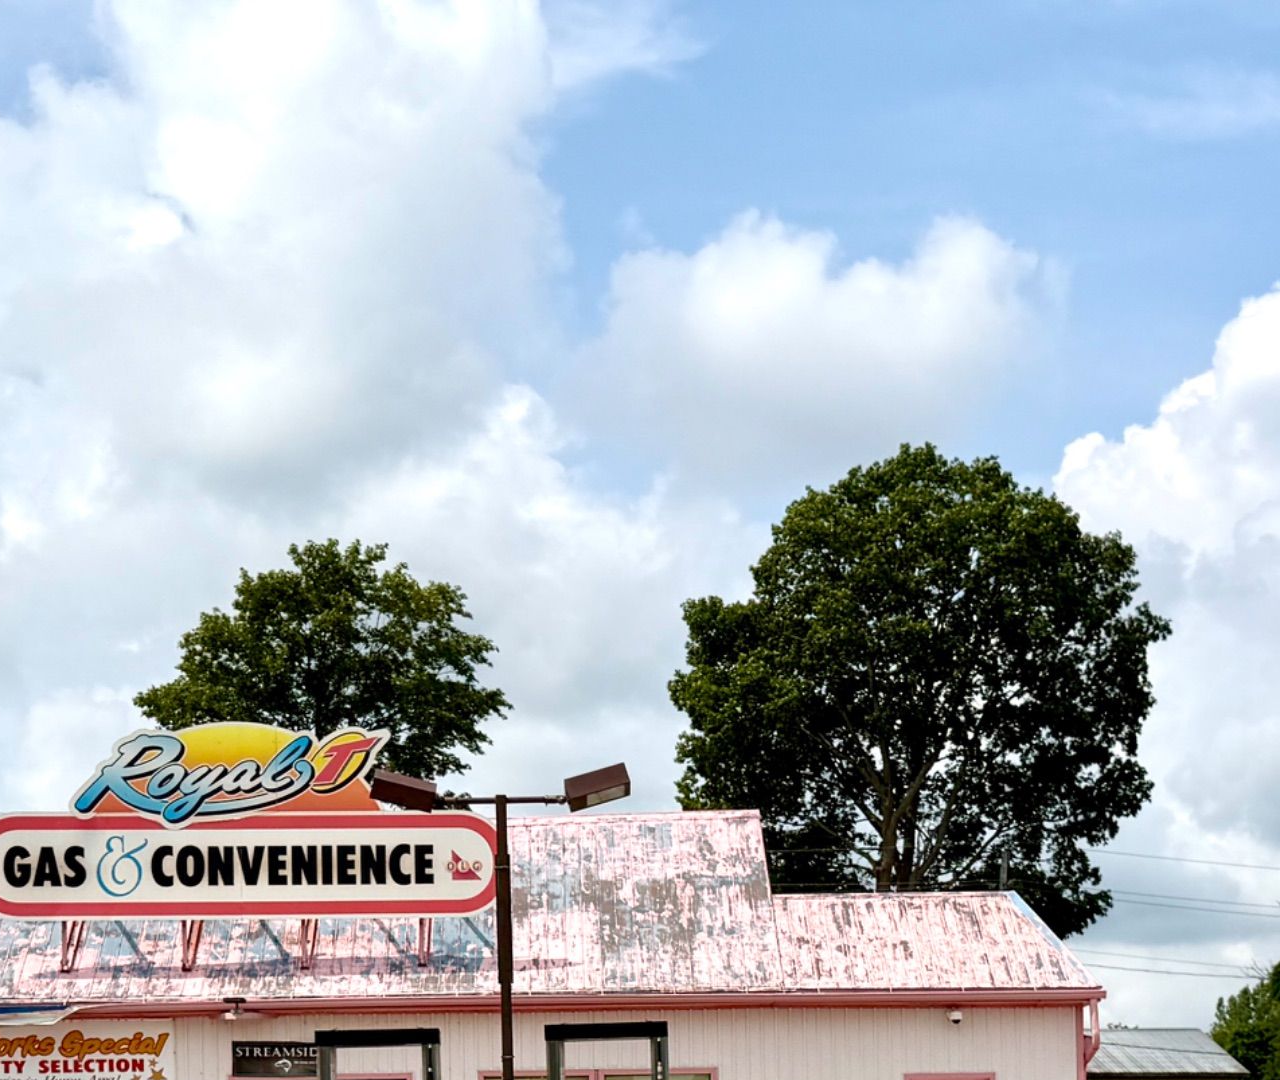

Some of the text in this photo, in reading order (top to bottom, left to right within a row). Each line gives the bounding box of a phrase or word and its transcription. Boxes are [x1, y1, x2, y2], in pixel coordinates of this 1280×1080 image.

[74, 733, 379, 824] Royal T
[2, 835, 435, 898] GAS & CONVENIENCE
[58, 1029, 170, 1062] Special
[235, 1046, 319, 1058] STREAMSID
[38, 1058, 145, 1074] SELECTION
